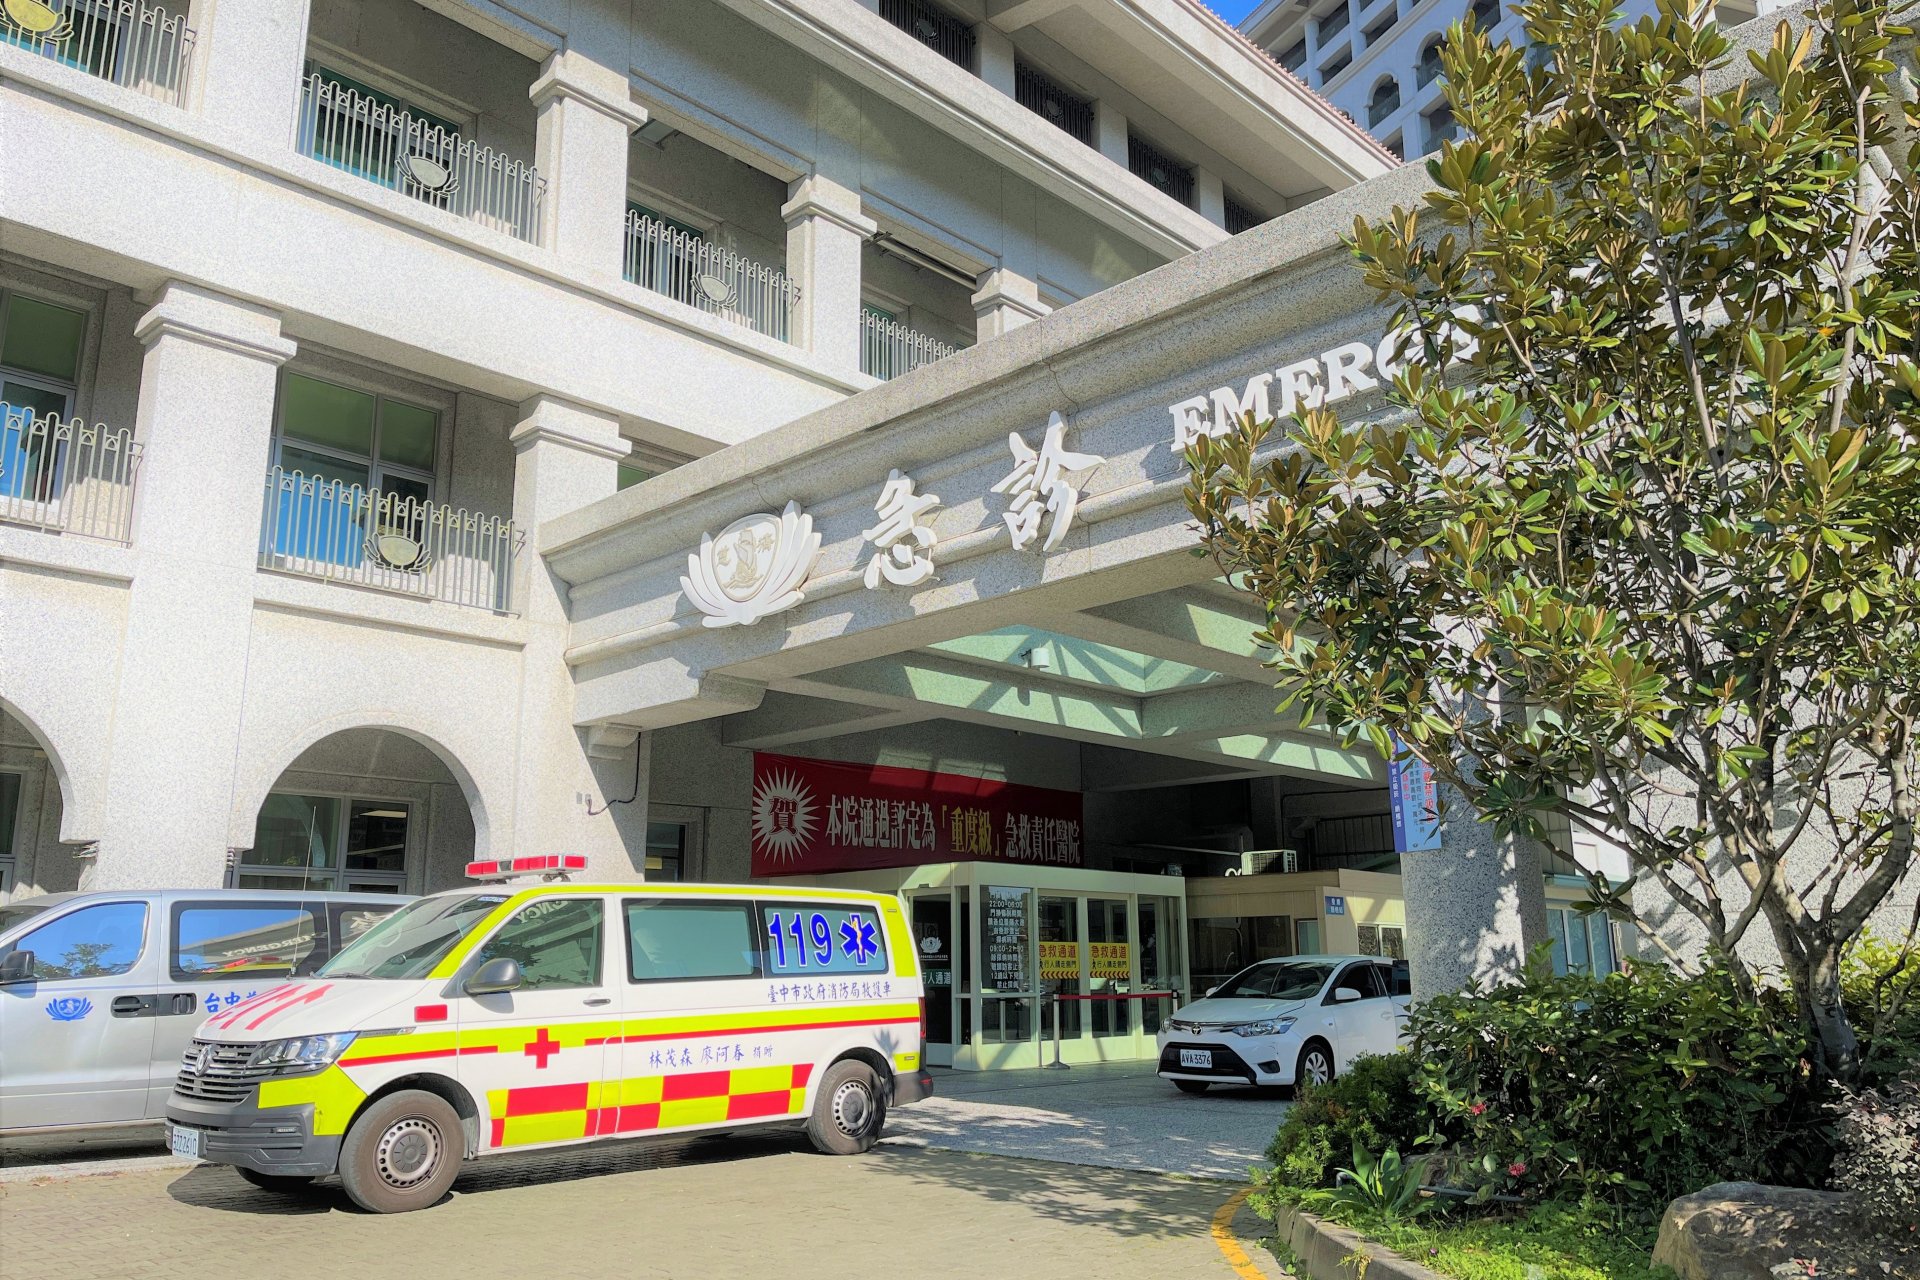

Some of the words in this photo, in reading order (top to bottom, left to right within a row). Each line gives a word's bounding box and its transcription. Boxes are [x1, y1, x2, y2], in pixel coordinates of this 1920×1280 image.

[862, 411, 1107, 590] 急診
[768, 796, 800, 837] 賀
[768, 912, 833, 967] 119
[1091, 945, 1128, 959] 急救通道
